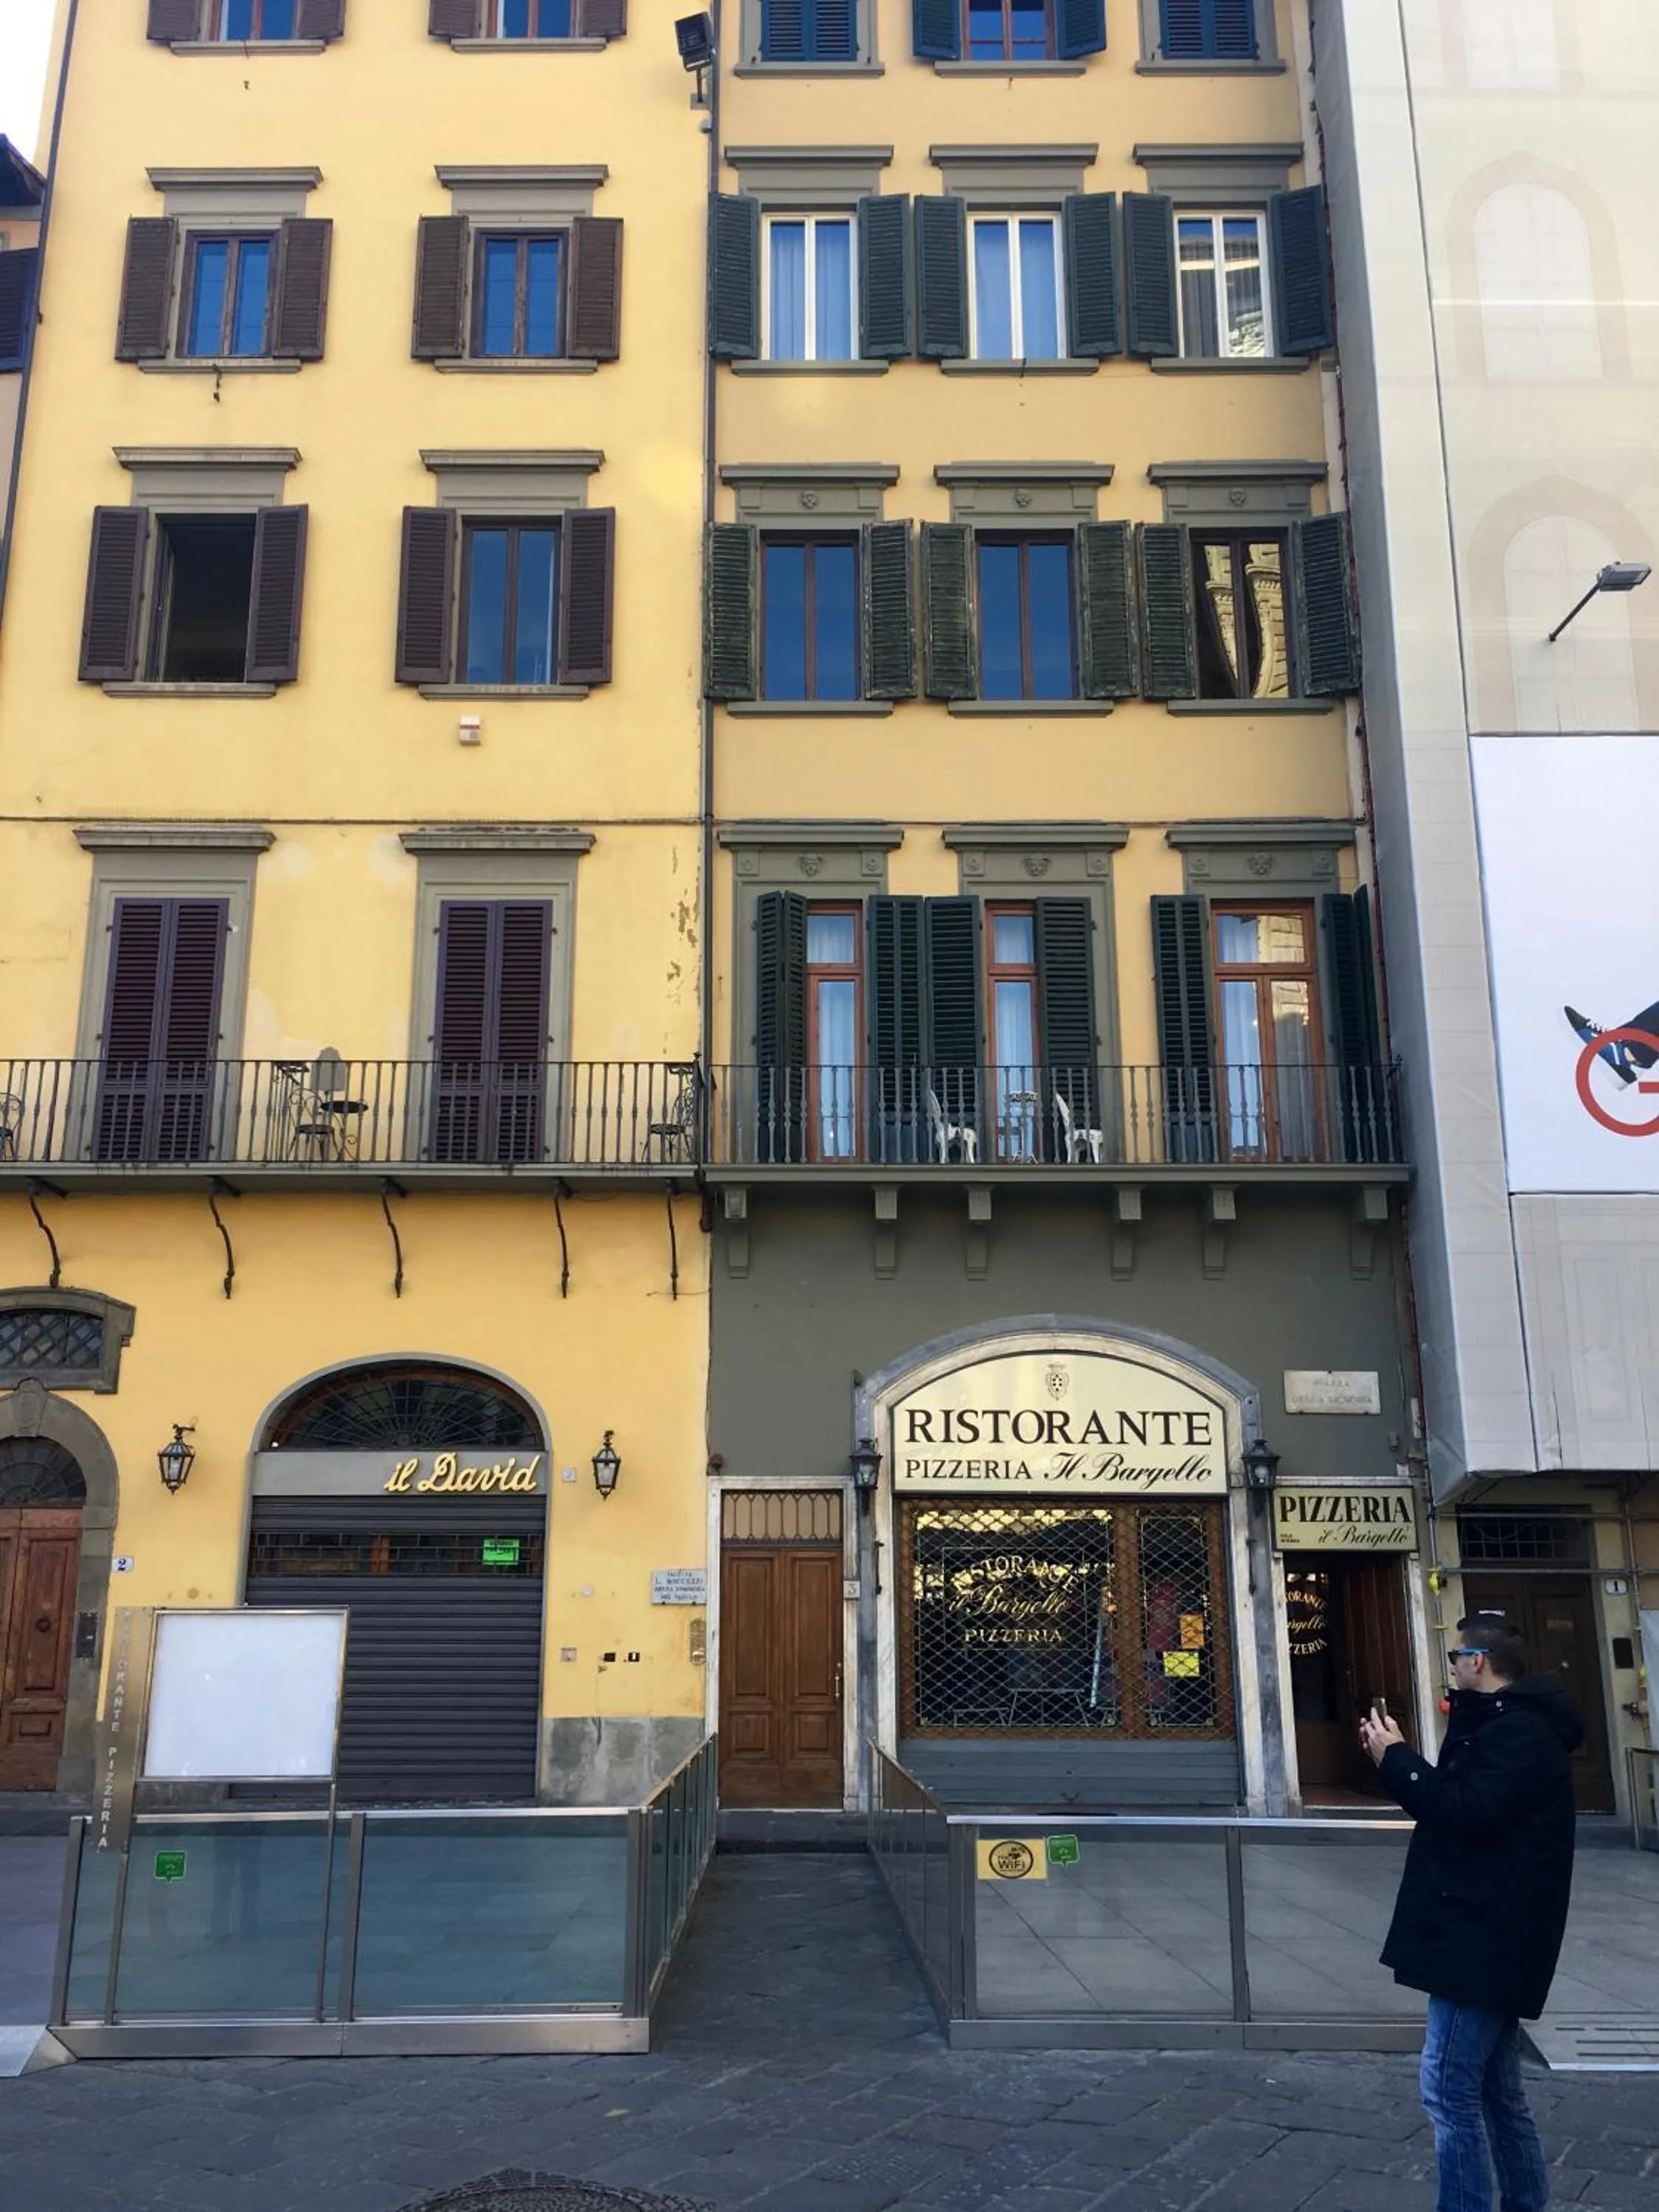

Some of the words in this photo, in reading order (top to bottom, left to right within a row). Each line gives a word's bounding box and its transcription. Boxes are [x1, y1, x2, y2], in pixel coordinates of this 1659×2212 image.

[905, 1409, 1211, 1445] RISTORANTE
[383, 1458, 418, 1492] il
[417, 1451, 541, 1492] David
[905, 1459, 1032, 1480] PIZZERIA
[1082, 1452, 1211, 1490] Bargello
[1279, 1496, 1413, 1523] PIZZERIA
[1335, 1524, 1409, 1547] Bargello
[118, 1558, 126, 1571] 2
[964, 1628, 1063, 1643] PIZZERIA
[111, 1609, 131, 1732] ORANTE
[97, 1747, 118, 1848] PIZZERIA
